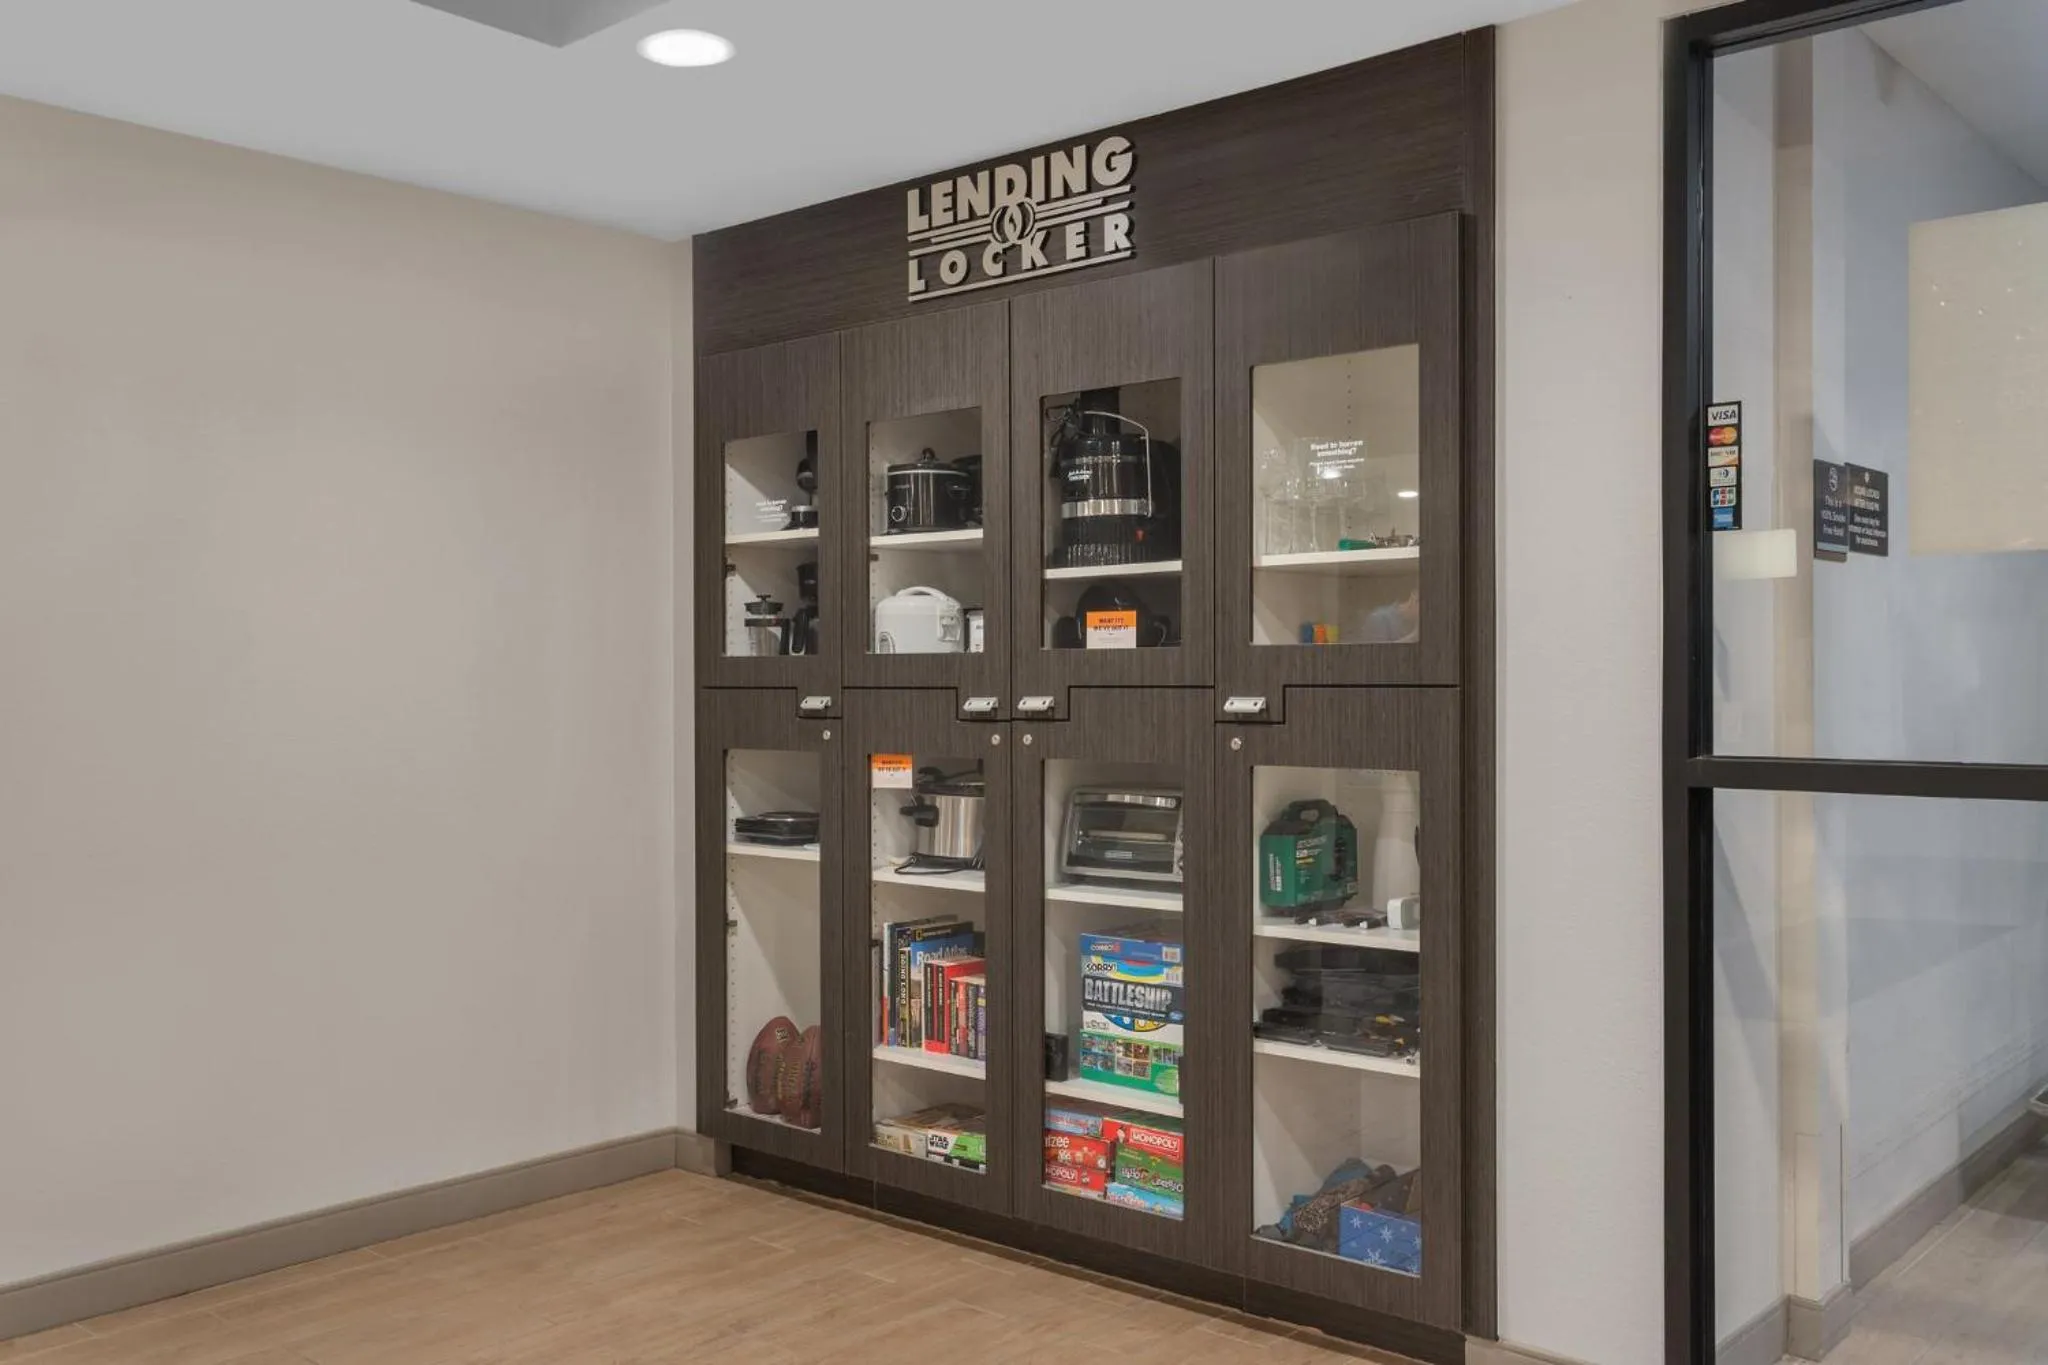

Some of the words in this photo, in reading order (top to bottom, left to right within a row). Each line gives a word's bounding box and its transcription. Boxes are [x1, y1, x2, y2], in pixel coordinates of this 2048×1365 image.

[907, 135, 1134, 234] LENDING
[908, 212, 1133, 294] LOCKER
[1711, 410, 1737, 420] VISA
[1085, 977, 1172, 1012] BATTLESHIP
[930, 1134, 949, 1142] STAR
[1132, 1130, 1178, 1150] MONOPOLY
